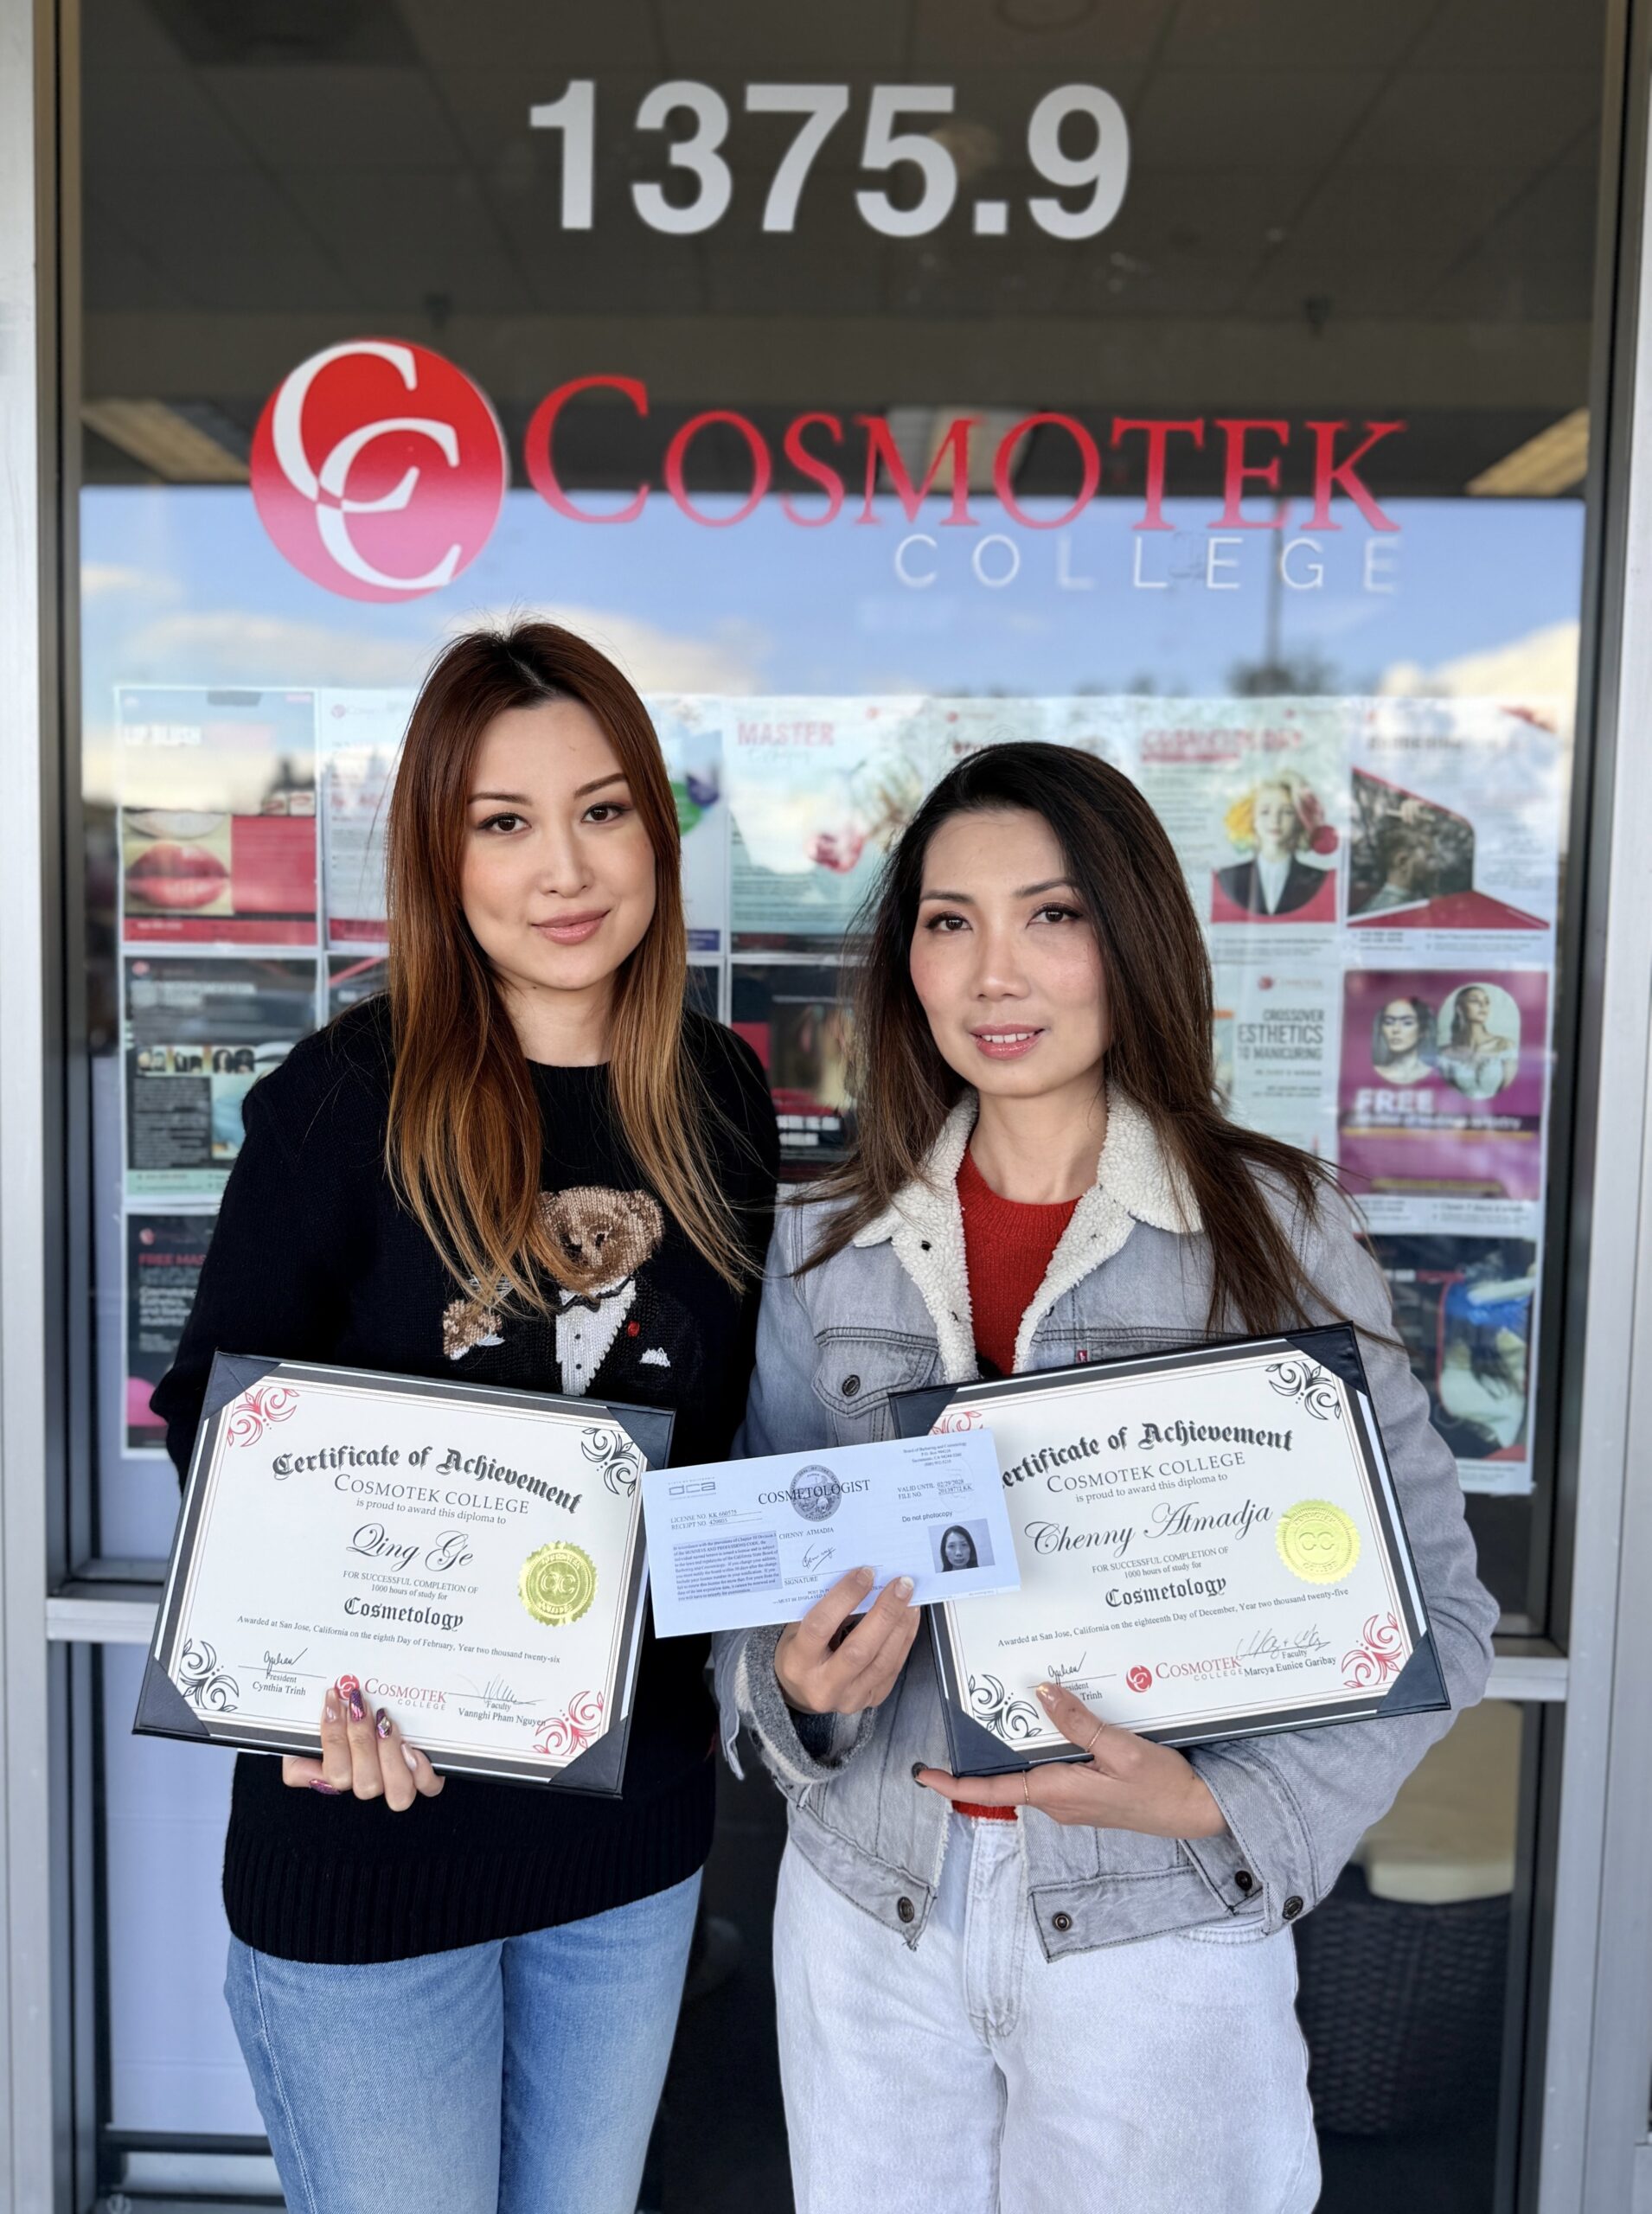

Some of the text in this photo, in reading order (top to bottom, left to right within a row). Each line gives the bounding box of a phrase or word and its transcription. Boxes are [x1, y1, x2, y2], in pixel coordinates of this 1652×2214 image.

[530, 80, 1130, 240] 1375.9
[524, 374, 1407, 533] COSMOTEK
[894, 534, 1401, 594] COLLEGE
[738, 721, 835, 746] MASTER
[1263, 1008, 1325, 1022] CROSSOVER
[1238, 1024, 1324, 1044] ESTHETICS
[1355, 1089, 1434, 1114] FREE
[1002, 1419, 1294, 1489] ertificate of Achievement
[272, 1445, 583, 1515] Certificate of Achievement
[1047, 1451, 1246, 1494] COSMOTEK COLLEGE
[334, 1474, 529, 1515] COSMOTEK COLLEGE
[669, 1481, 716, 1496] dca
[758, 1479, 871, 1505] COSMETOLOGIST
[917, 1482, 935, 1491] UNTIL
[1076, 1473, 1227, 1504] is proud to award this diploma to
[356, 1497, 506, 1525] is proud to award this diploma to
[671, 1514, 696, 1524] LICENSE
[922, 1511, 953, 1521] photocopy
[779, 1531, 804, 1540] CHENNY
[1024, 1499, 1274, 1558] Chenny Atmadja
[346, 1523, 474, 1572] Qing Ge
[1092, 1545, 1228, 1574] FOR SUCCESSFUL COMPLETION OF
[784, 1576, 818, 1586] SIGNATURE
[1124, 1560, 1201, 1579] 1000 hours of study for
[343, 1570, 478, 1595] FOR SUCCESSFUL COMPLETION OF
[371, 1584, 448, 1601] 1000 hours of study for
[1105, 1577, 1226, 1607] Cosmetology
[344, 1597, 464, 1633] Cosmetology
[998, 1635, 1029, 1648] Awarded
[1031, 1634, 1038, 1642] at
[1039, 1632, 1053, 1641] San
[1054, 1629, 1072, 1639] Jose,
[1073, 1622, 1109, 1635] California
[1121, 1620, 1132, 1629] the
[1134, 1614, 1171, 1628] eighteenth
[1172, 1612, 1187, 1622] Day
[1189, 1609, 1197, 1619] of
[1199, 1605, 1238, 1617] December,
[1239, 1602, 1256, 1611] Year
[1258, 1600, 1271, 1609] two
[1273, 1593, 1306, 1606] thousand
[1307, 1588, 1348, 1601] twenty-five
[237, 1615, 269, 1626] Awarded
[279, 1620, 292, 1629] San
[293, 1622, 311, 1633] Jose,
[313, 1624, 348, 1636] California
[361, 1630, 371, 1640] the
[373, 1632, 394, 1643] eighth
[396, 1635, 411, 1647] Day
[413, 1637, 422, 1646] of
[458, 1642, 474, 1653] Year
[477, 1646, 490, 1654] two
[491, 1647, 522, 1659] thousand
[524, 1652, 560, 1664] twenty-six
[1244, 1656, 1337, 1677] Marcya Eunice Garibay
[1282, 1649, 1308, 1660] Faculty
[1156, 1656, 1242, 1680] COSMOTEK
[1194, 1668, 1244, 1681] COLLEGE
[253, 1681, 306, 1696] Cynthia Trinh
[365, 1678, 447, 1704] COSMOTEK
[1080, 1691, 1103, 1701] Trinh
[398, 1699, 446, 1711] COLLEGE
[486, 1700, 512, 1712] Faculty
[492, 1712, 515, 1723] Pham
